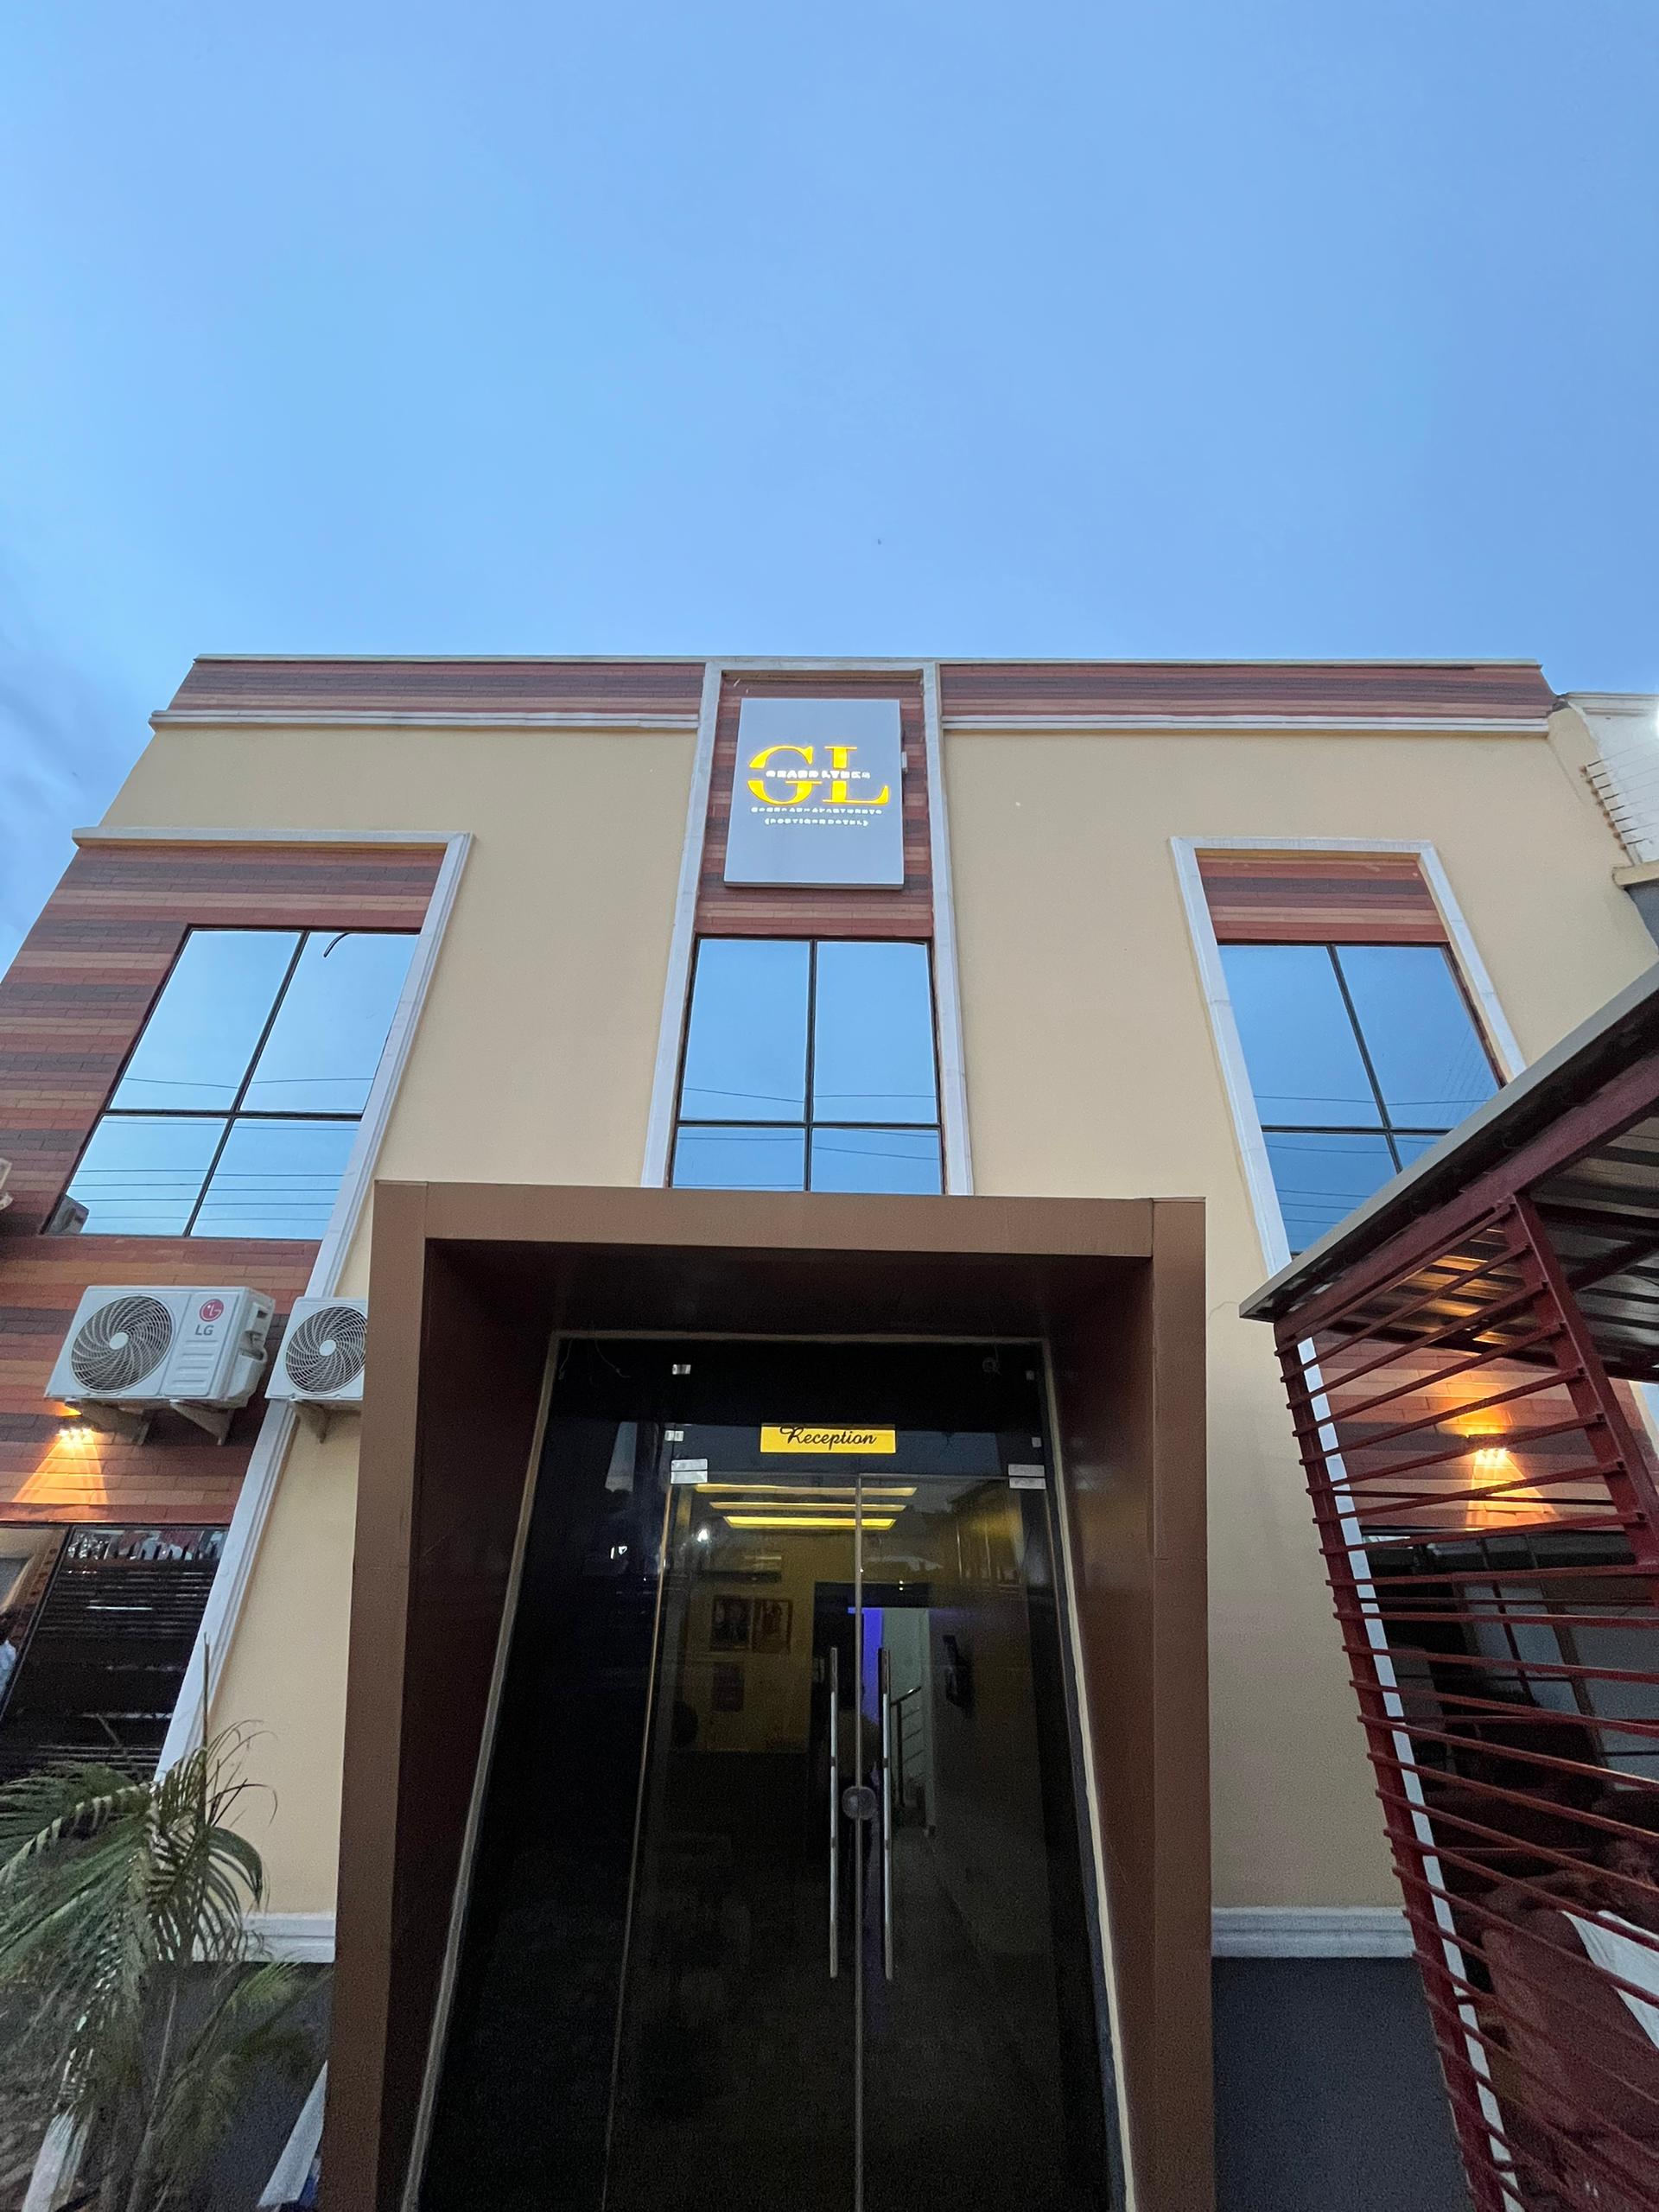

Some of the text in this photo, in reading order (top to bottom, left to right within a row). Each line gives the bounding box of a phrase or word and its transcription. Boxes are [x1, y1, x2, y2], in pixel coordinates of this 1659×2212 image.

[747, 745, 889, 805] GL
[765, 770, 818, 779] GRAND
[194, 1324, 214, 1336] LG
[779, 1426, 877, 1451] Reception
